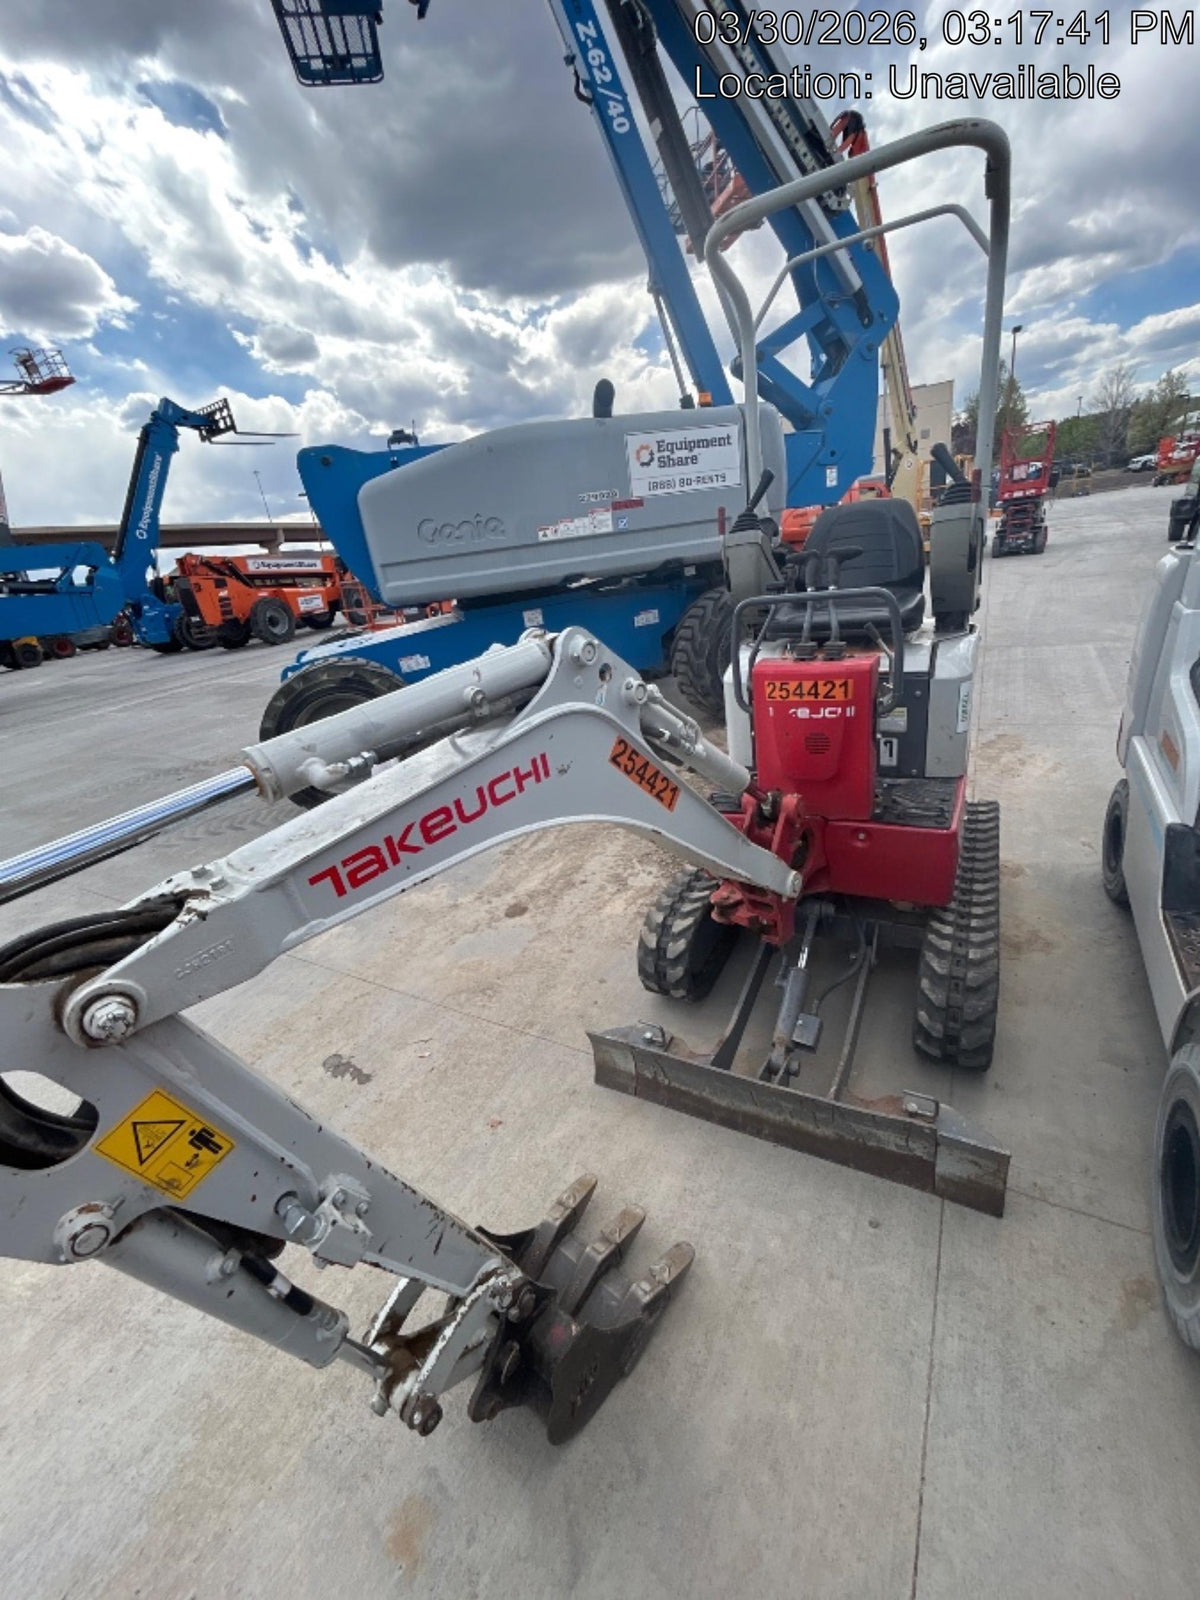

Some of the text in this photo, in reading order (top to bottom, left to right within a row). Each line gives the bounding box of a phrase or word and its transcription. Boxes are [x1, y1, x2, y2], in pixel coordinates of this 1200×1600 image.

[575, 20, 630, 134] Z-62/40
[656, 433, 732, 454] Equipment
[657, 454, 699, 468] Share
[766, 680, 850, 700] 254421
[609, 736, 681, 811] 254421
